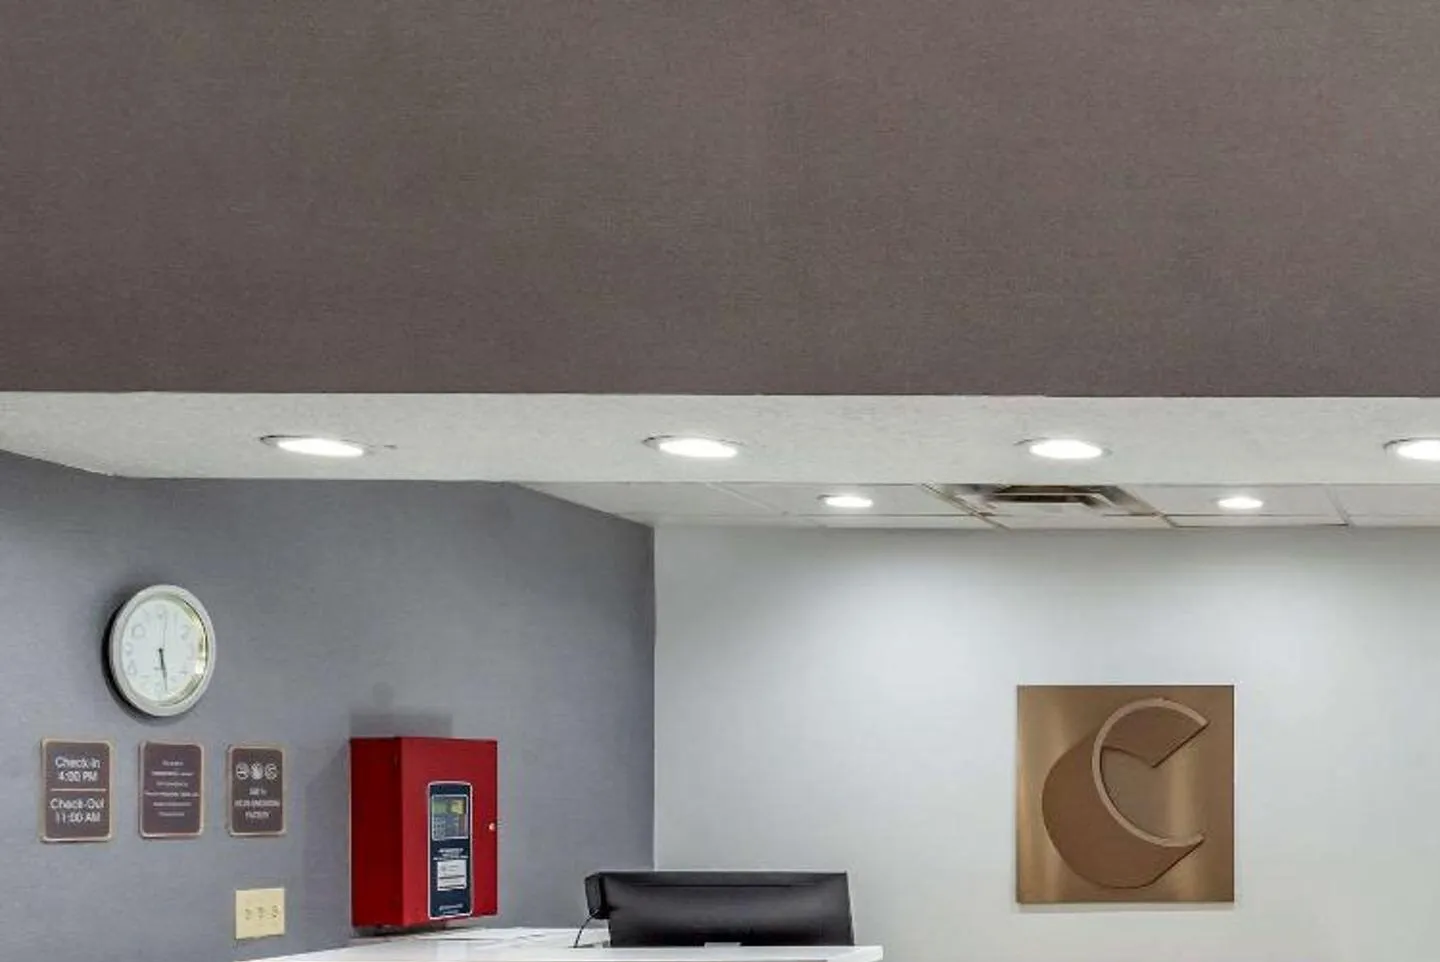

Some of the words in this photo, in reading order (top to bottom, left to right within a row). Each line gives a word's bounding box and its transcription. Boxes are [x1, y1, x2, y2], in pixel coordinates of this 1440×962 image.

[58, 770, 81, 782] 4:00
[82, 770, 99, 782] PM
[56, 811, 84, 824] 11:00
[85, 811, 101, 823] AM
